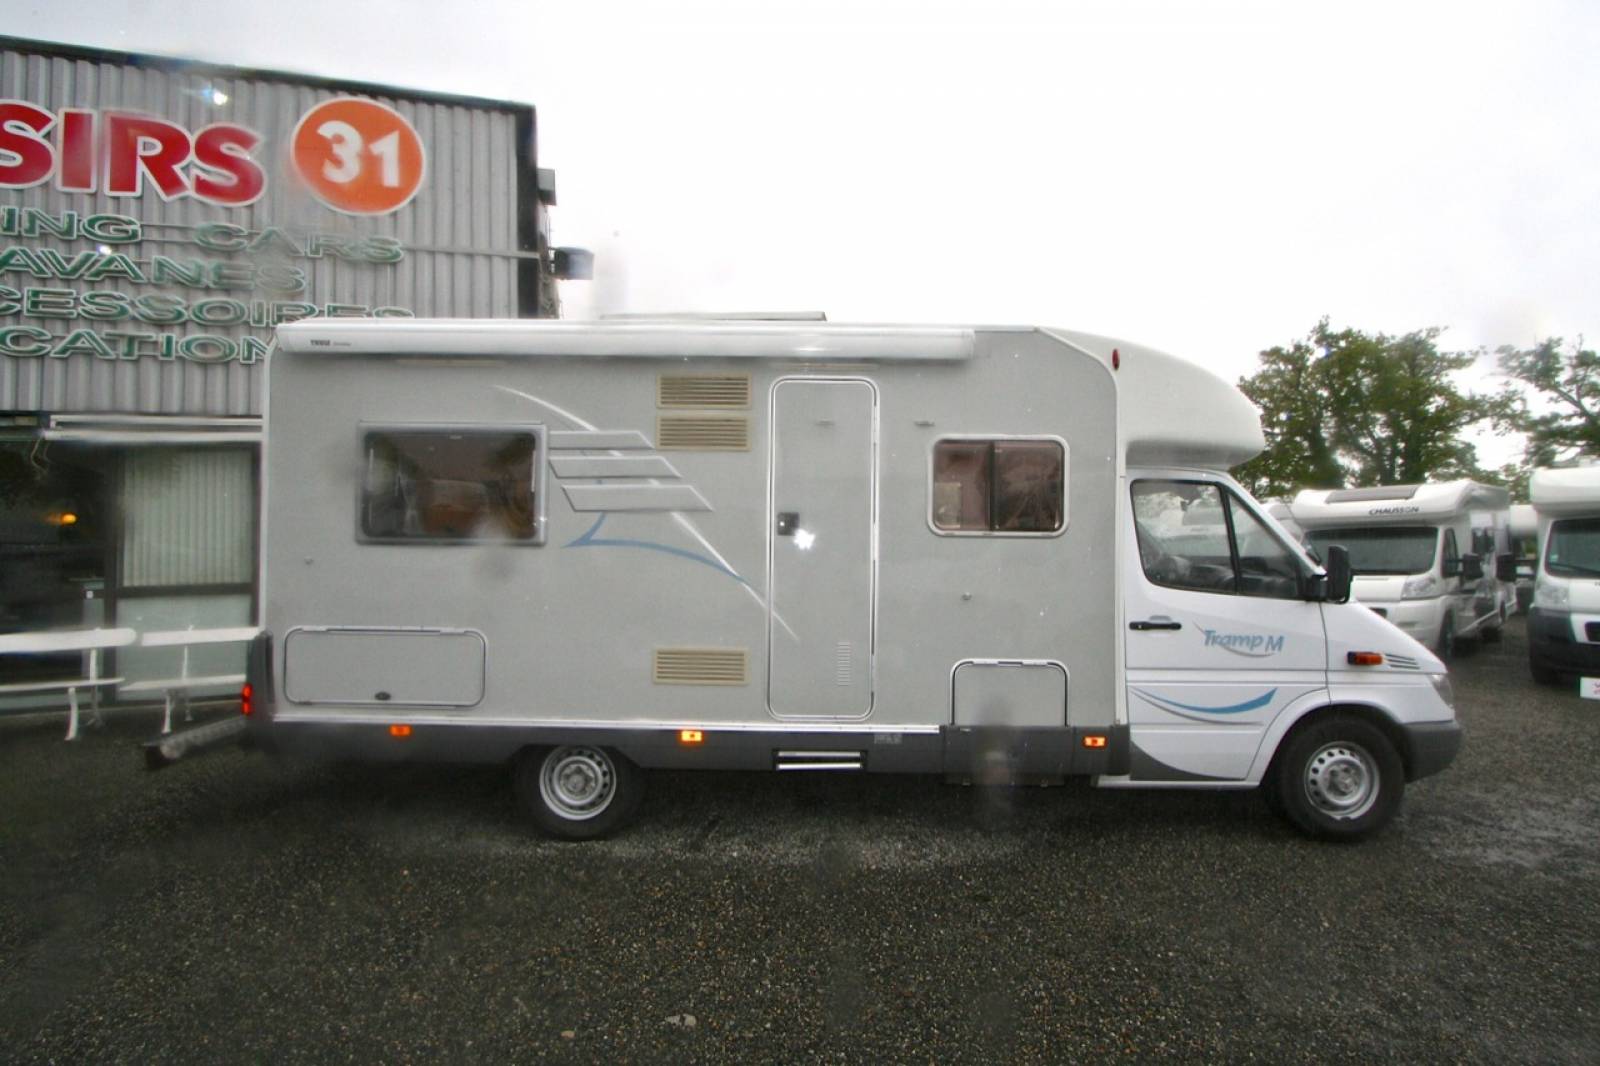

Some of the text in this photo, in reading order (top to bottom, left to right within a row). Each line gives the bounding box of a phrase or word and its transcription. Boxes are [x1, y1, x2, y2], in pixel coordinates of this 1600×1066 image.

[0, 99, 401, 207] SIRS 31
[0, 207, 404, 263] ING CARS
[0, 246, 306, 292] AVANES
[1368, 506, 1420, 516] CHAUSSON
[1204, 629, 1285, 653] Tramp M
